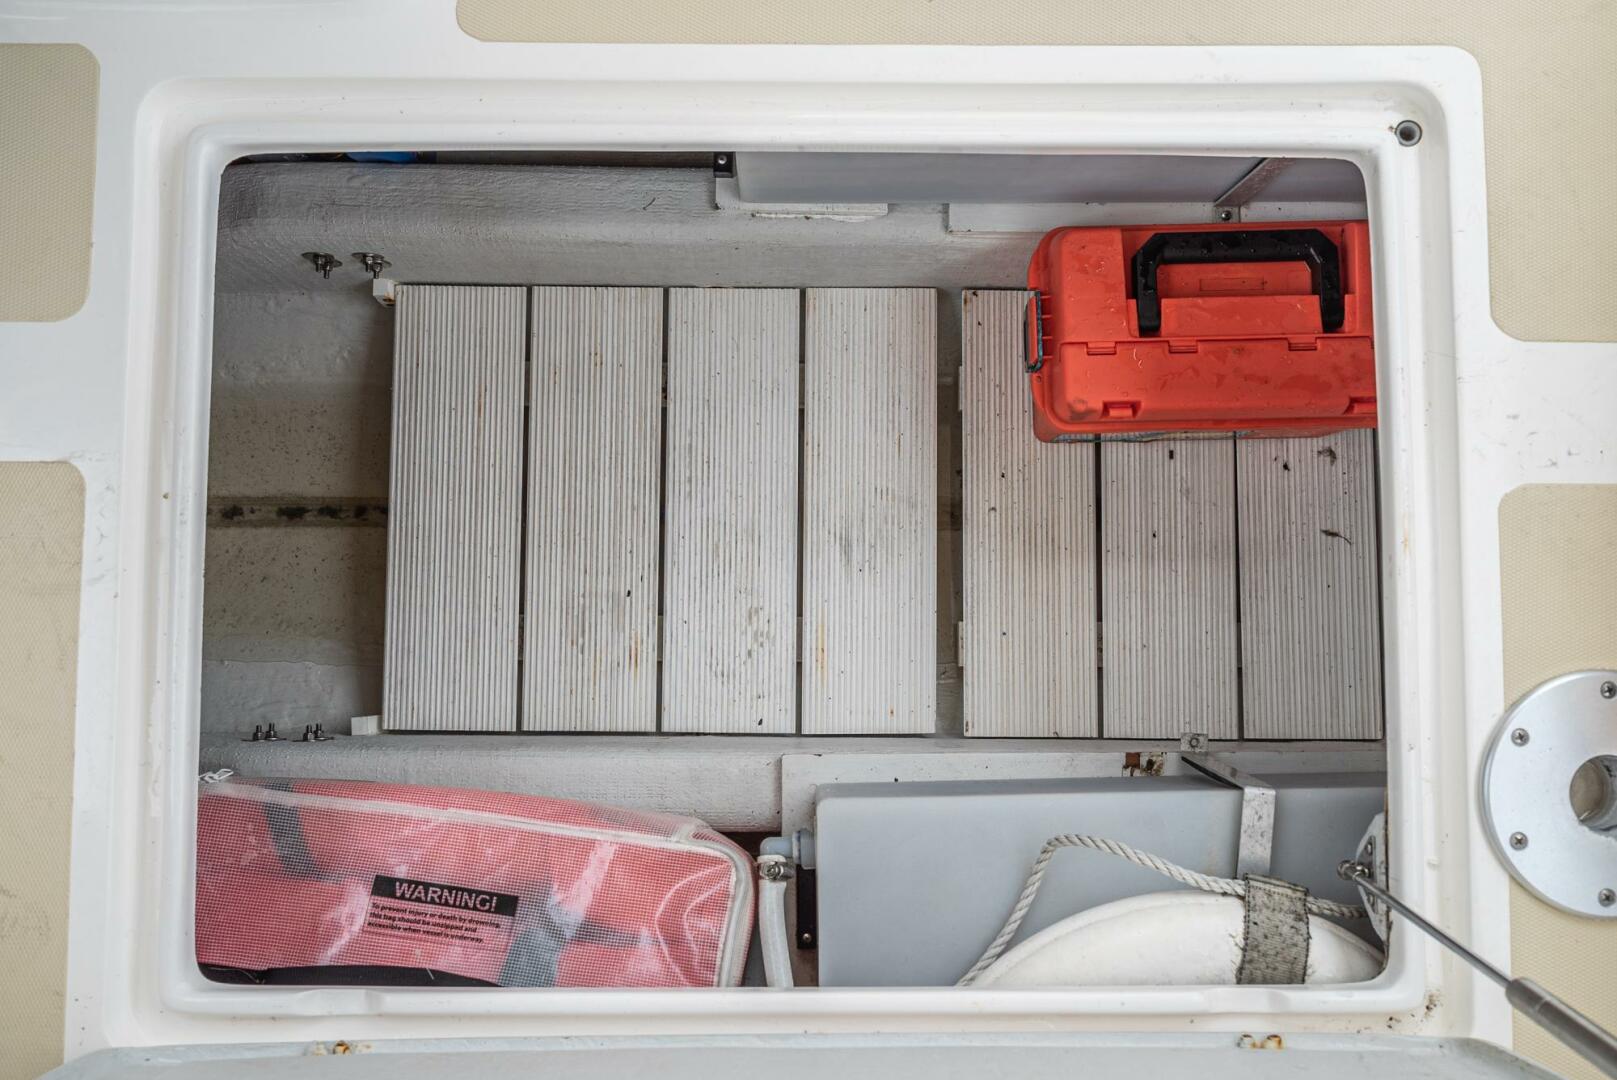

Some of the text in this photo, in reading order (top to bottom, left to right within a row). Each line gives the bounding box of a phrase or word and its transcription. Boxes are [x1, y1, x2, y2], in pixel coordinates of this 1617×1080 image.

[395, 881, 497, 912] WARNING!
[381, 905, 407, 914] prevent
[408, 909, 429, 918] injury
[438, 912, 458, 920] death
[458, 916, 468, 924] by
[383, 913, 397, 922] bag
[397, 916, 421, 925] should
[431, 921, 464, 931] unzipped
[368, 921, 402, 931] accessible
[422, 929, 443, 937] vessel
[450, 934, 484, 944] underway.
